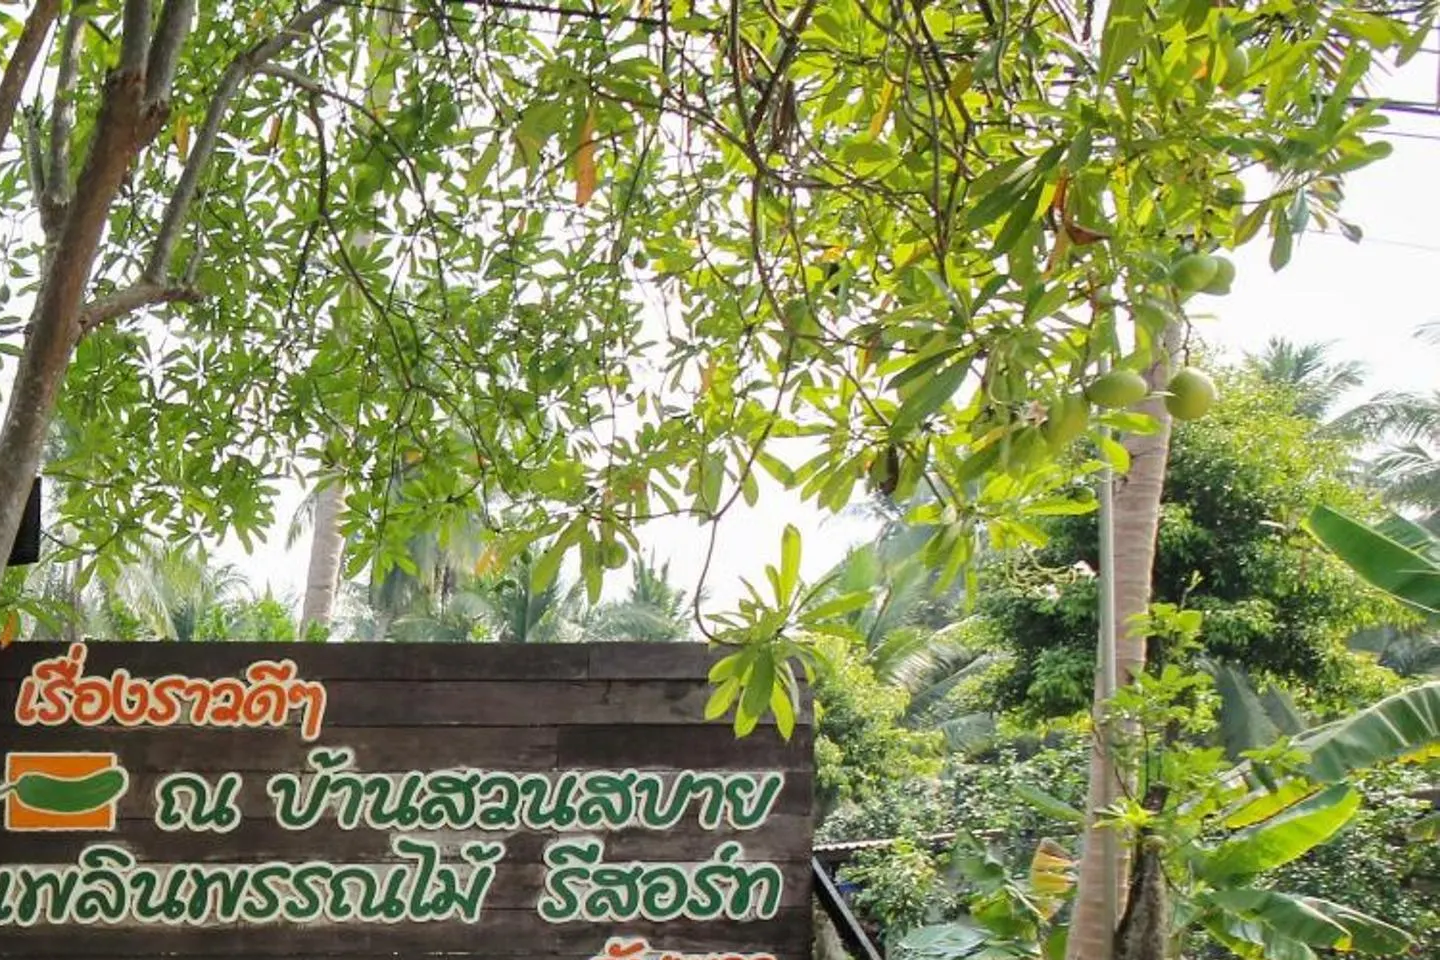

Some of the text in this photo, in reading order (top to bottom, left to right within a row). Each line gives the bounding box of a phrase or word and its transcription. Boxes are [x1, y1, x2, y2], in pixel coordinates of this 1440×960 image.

[15, 643, 326, 740] เรื่องราวดีๆ
[155, 746, 784, 833] ณ บ้านสวนสบาย
[537, 838, 783, 922] รีสอร์ท
